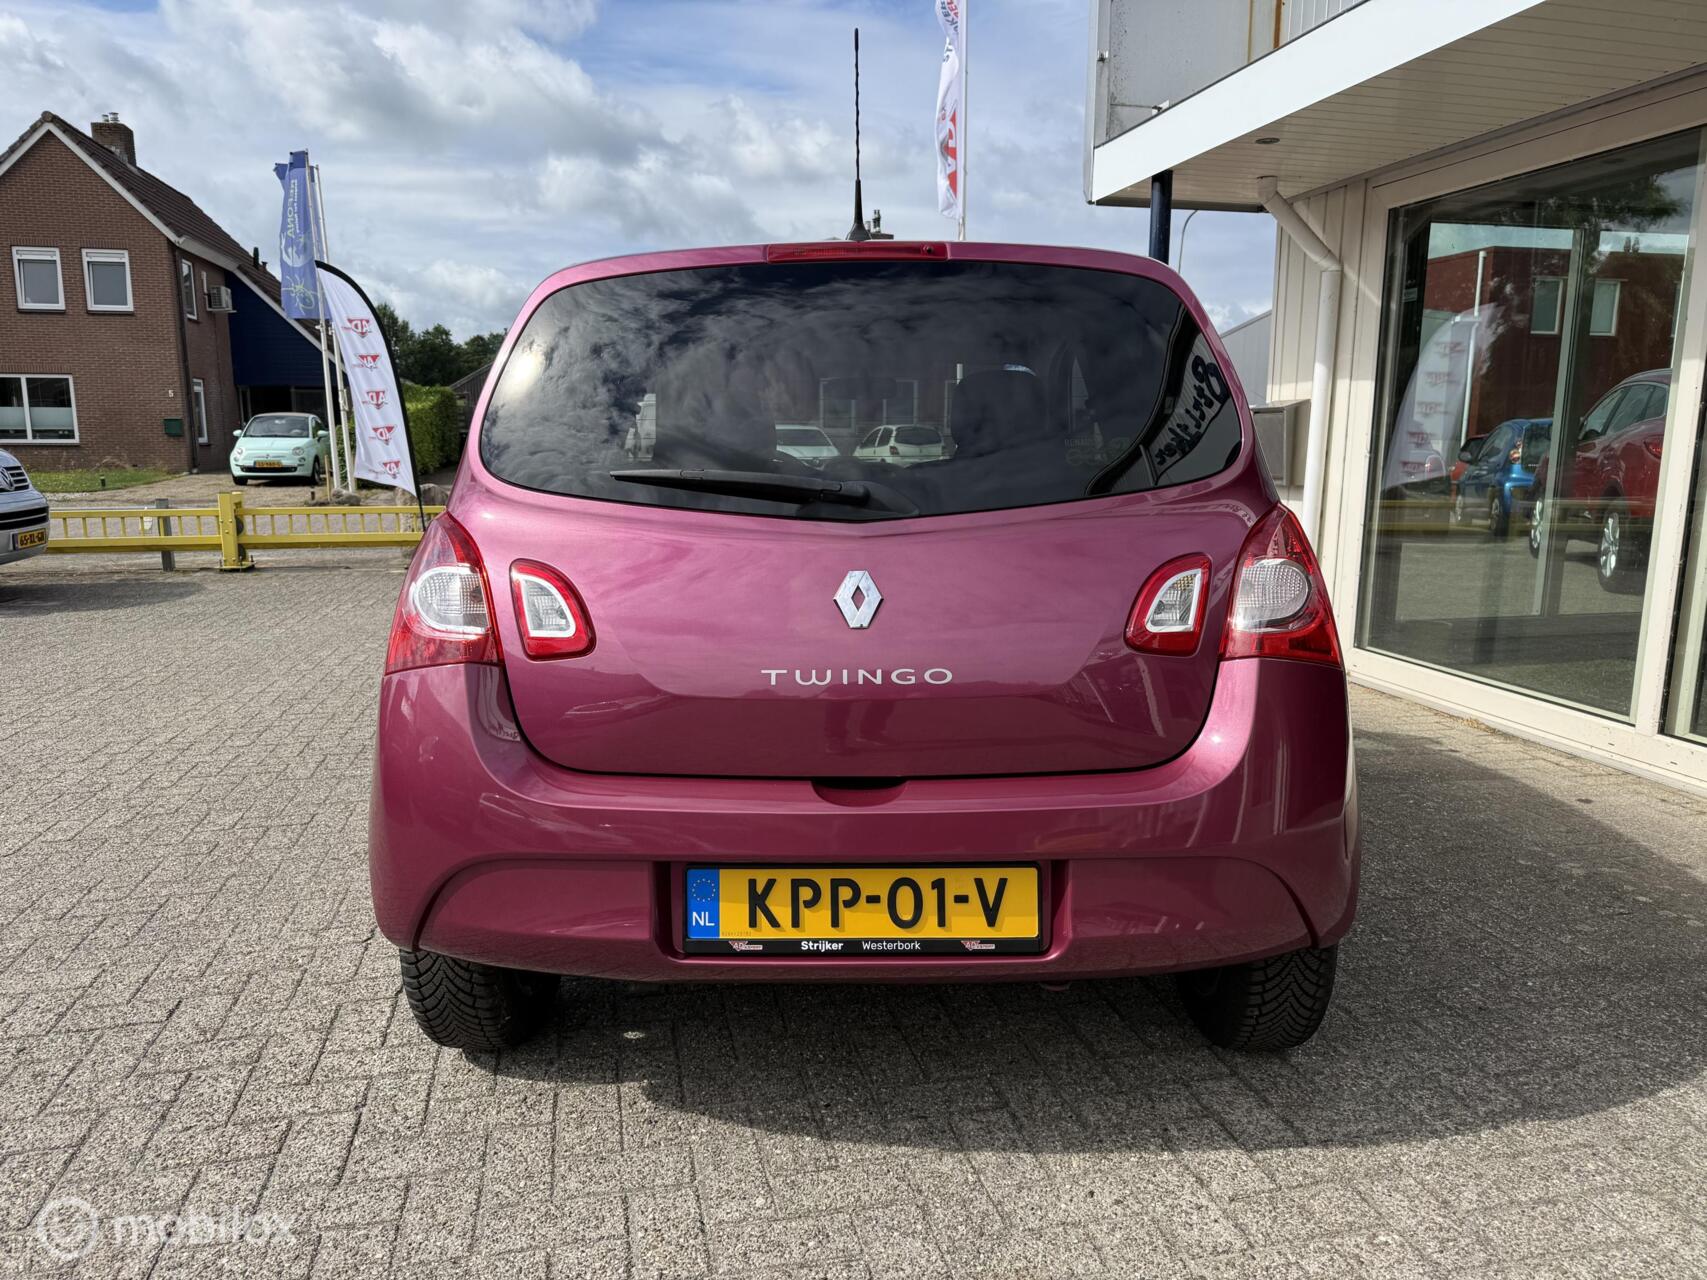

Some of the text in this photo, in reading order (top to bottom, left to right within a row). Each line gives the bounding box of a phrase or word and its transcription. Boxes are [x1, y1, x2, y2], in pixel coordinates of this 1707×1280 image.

[168, 389, 174, 398] 5
[760, 667, 953, 686] TWINGO
[747, 876, 1009, 930] KPP-01-V
[692, 911, 715, 927] NL
[800, 940, 921, 952] Strijker Westerbork
